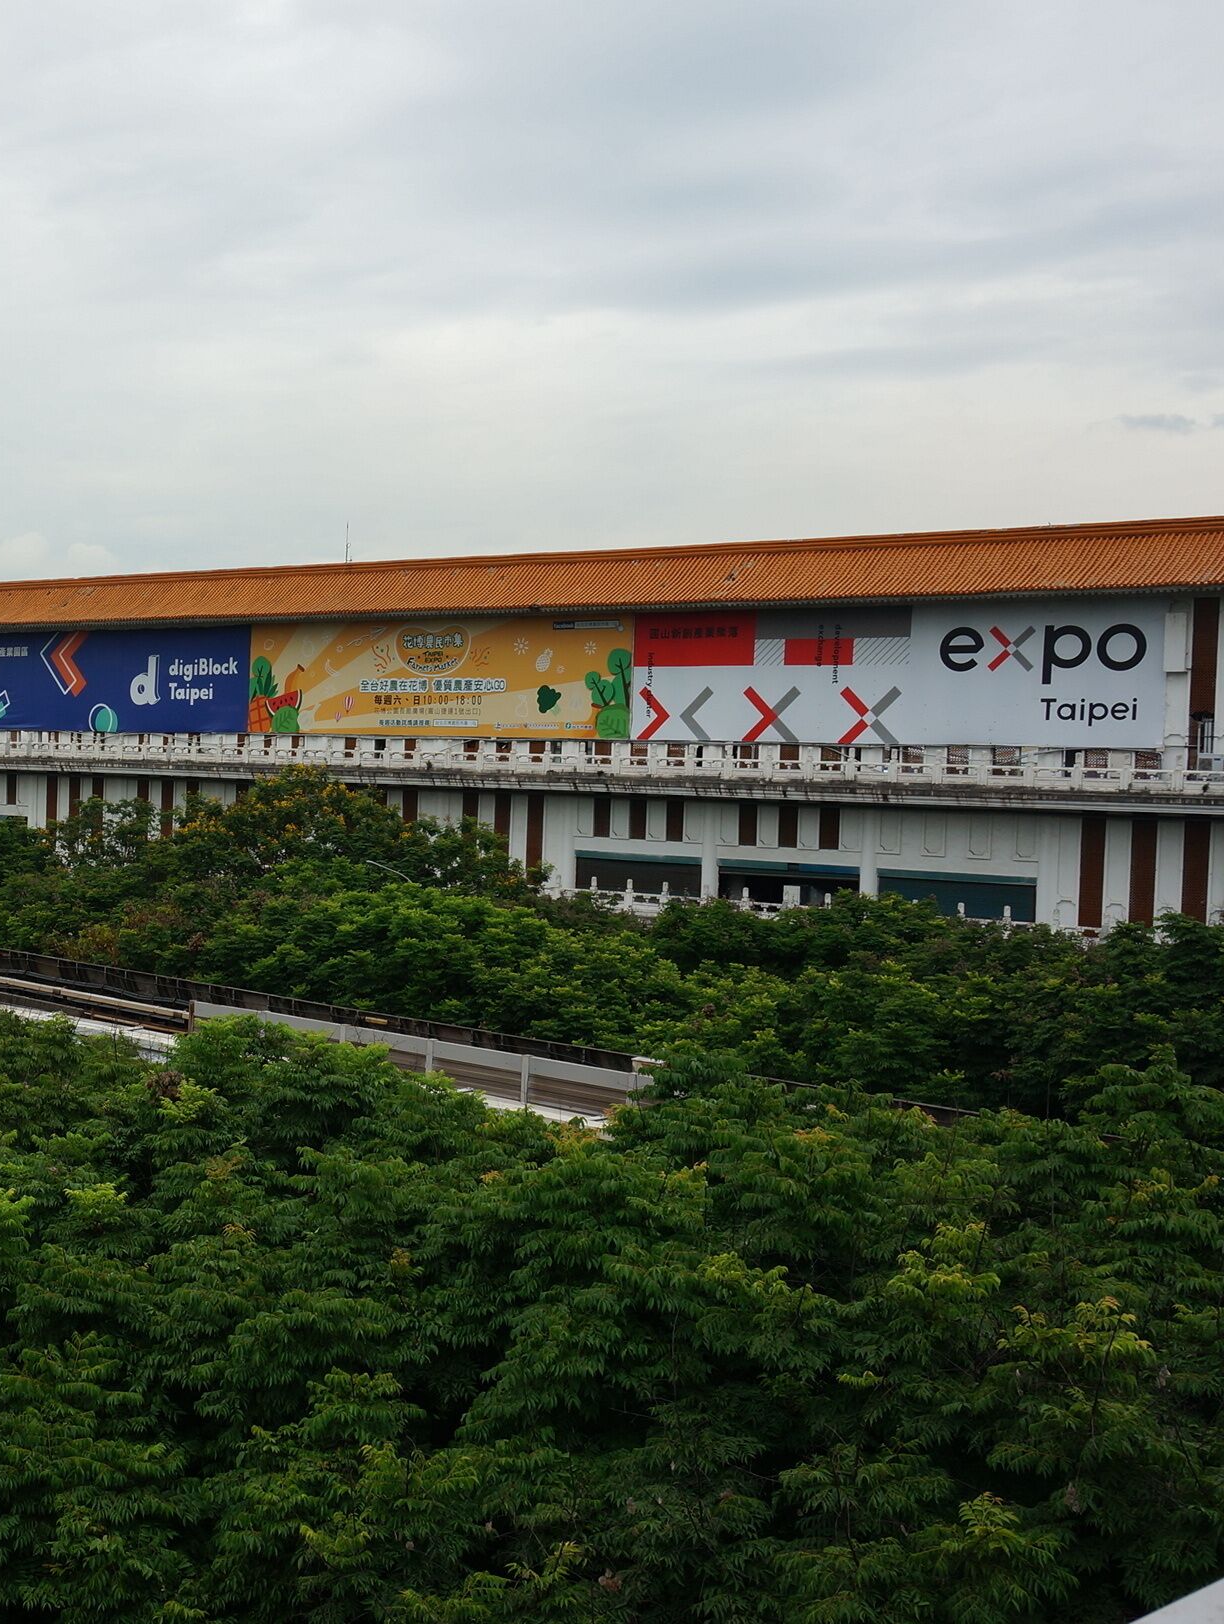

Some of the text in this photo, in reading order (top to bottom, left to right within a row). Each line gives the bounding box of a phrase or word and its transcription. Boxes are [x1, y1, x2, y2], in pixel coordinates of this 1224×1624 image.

[403, 631, 464, 649] 花博農民市集
[832, 624, 843, 685] development
[939, 623, 1147, 685] expo
[168, 656, 238, 682] digiBlock
[168, 682, 214, 706] Taipei
[360, 679, 428, 692] 全台好農在花博
[1040, 698, 1138, 726] Taipei
